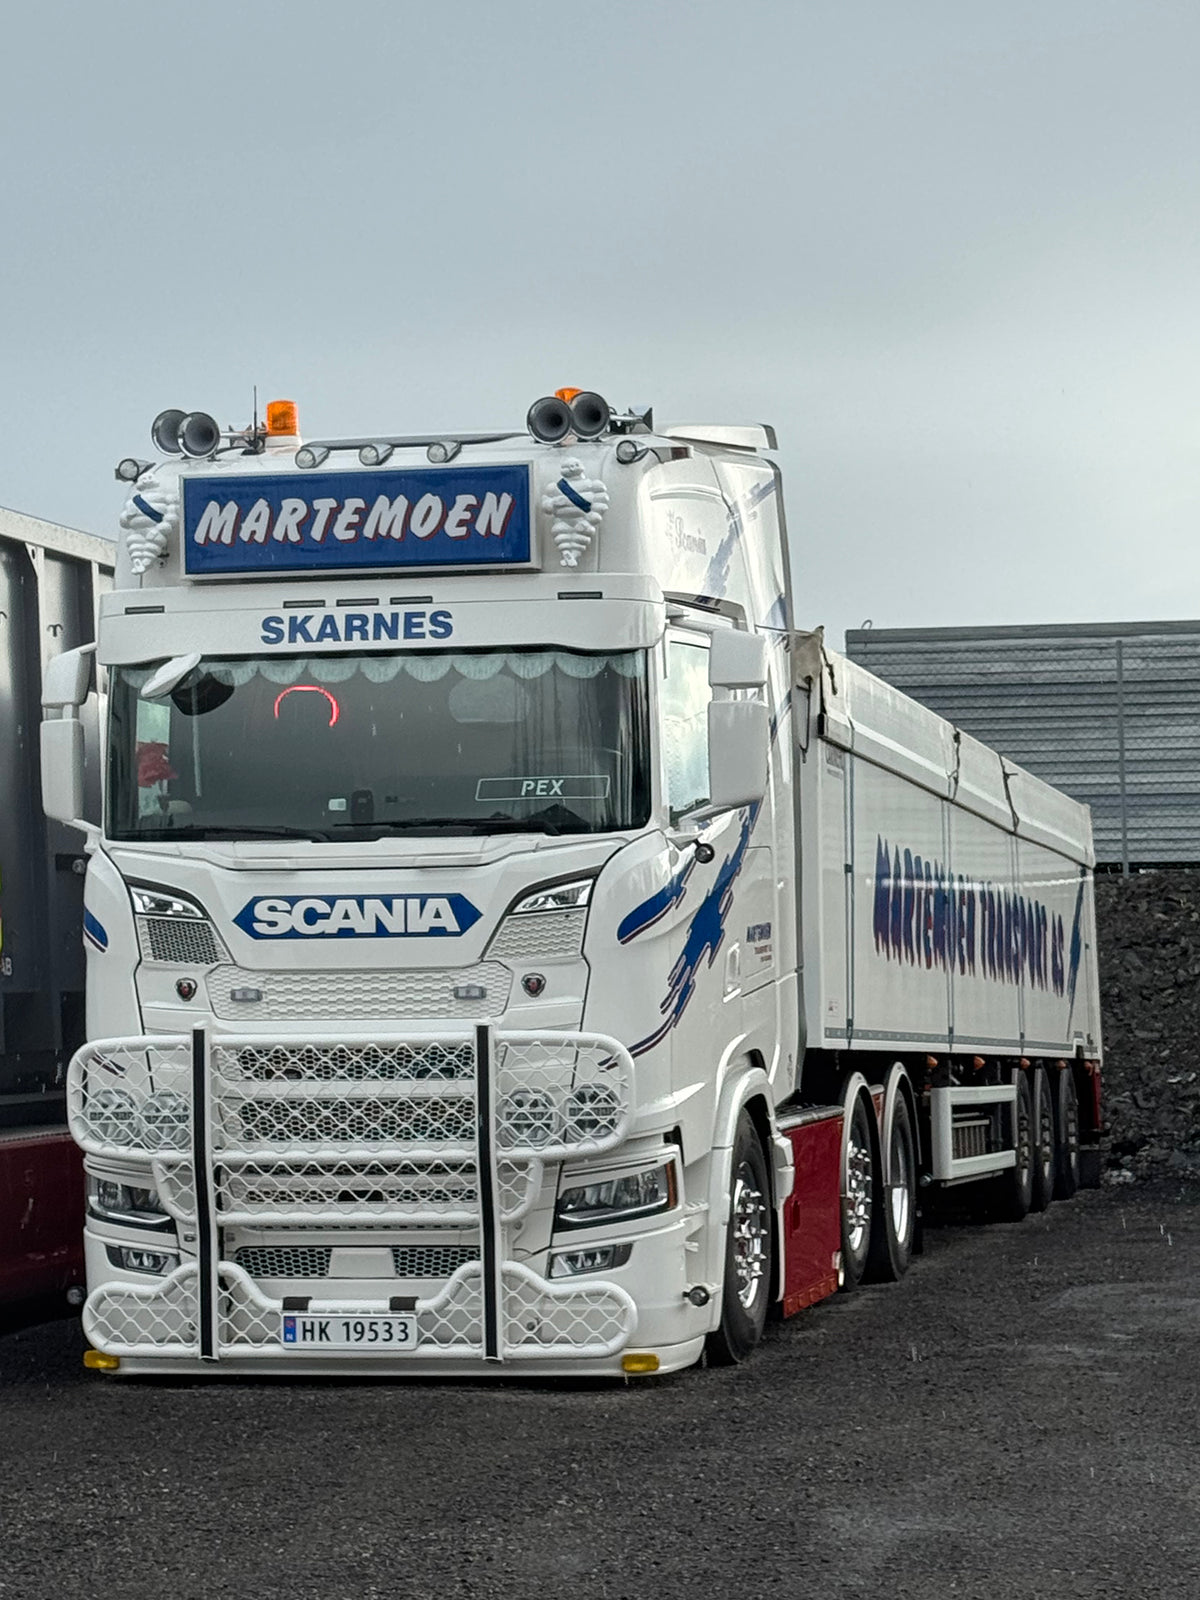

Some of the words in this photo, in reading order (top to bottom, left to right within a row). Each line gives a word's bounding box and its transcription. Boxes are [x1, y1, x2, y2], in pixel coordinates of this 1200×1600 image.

[193, 491, 516, 547] MARTEMOEN
[261, 610, 453, 645] SKARNES
[520, 778, 565, 797] PEX
[252, 897, 462, 936] SCANIA
[301, 1320, 332, 1342] HK
[342, 1320, 410, 1342] 19533
